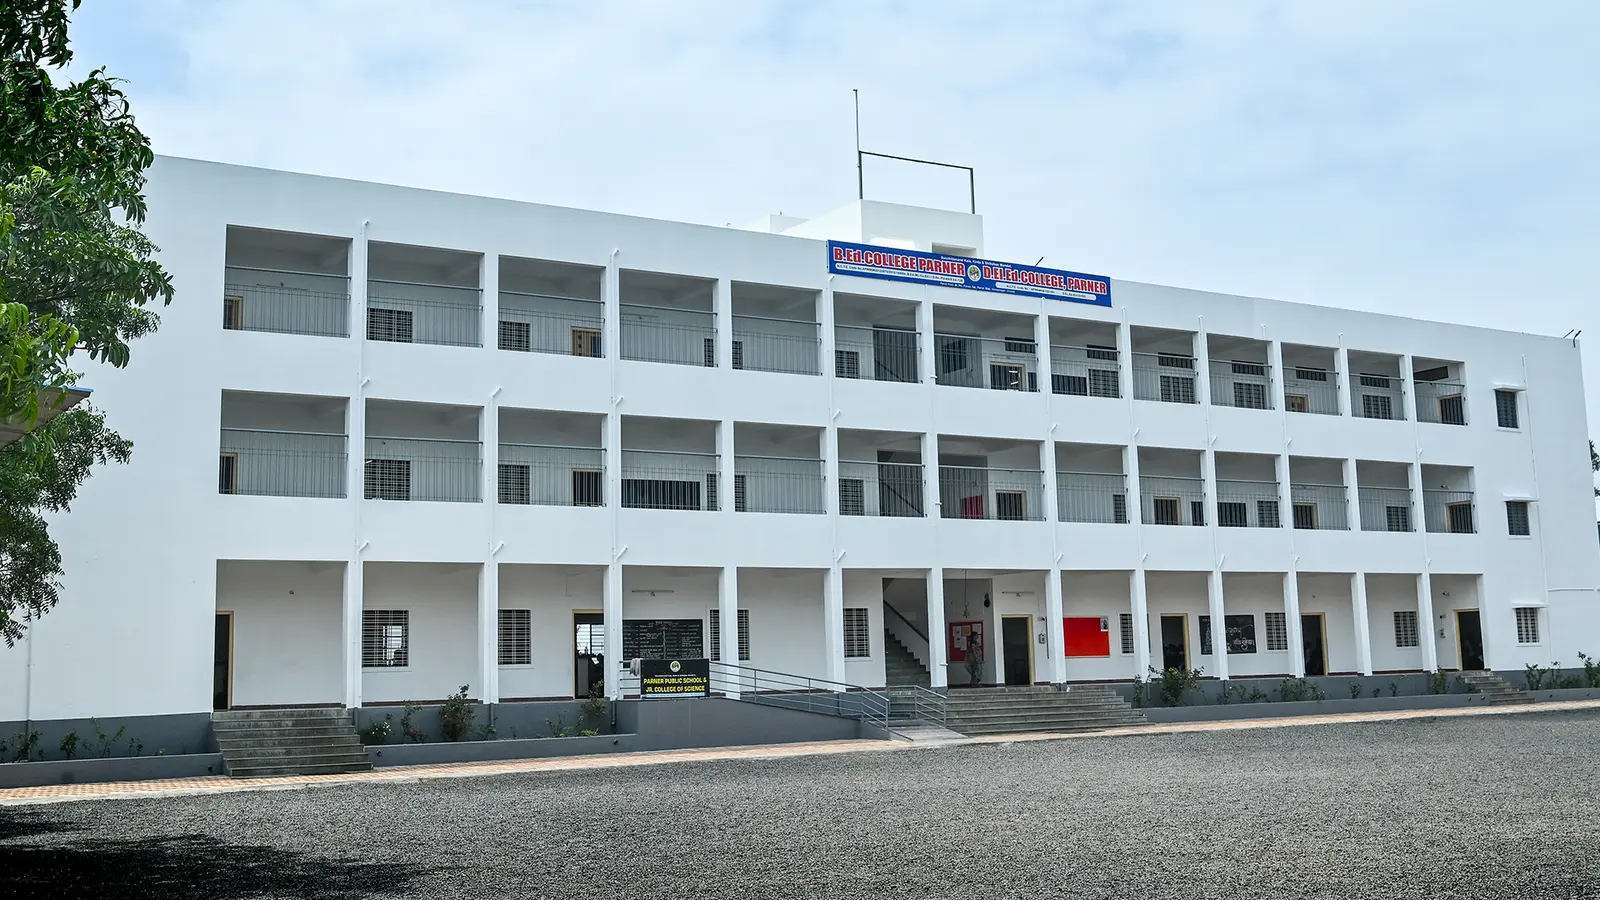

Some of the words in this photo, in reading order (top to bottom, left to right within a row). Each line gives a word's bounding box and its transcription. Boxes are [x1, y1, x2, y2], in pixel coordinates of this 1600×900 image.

[833, 247, 916, 270] B.Ed.COLLEGE
[919, 258, 965, 276] PARNER
[983, 266, 1066, 289] D.El.Ed.COLLEGE,
[1068, 277, 1107, 294] PARNER
